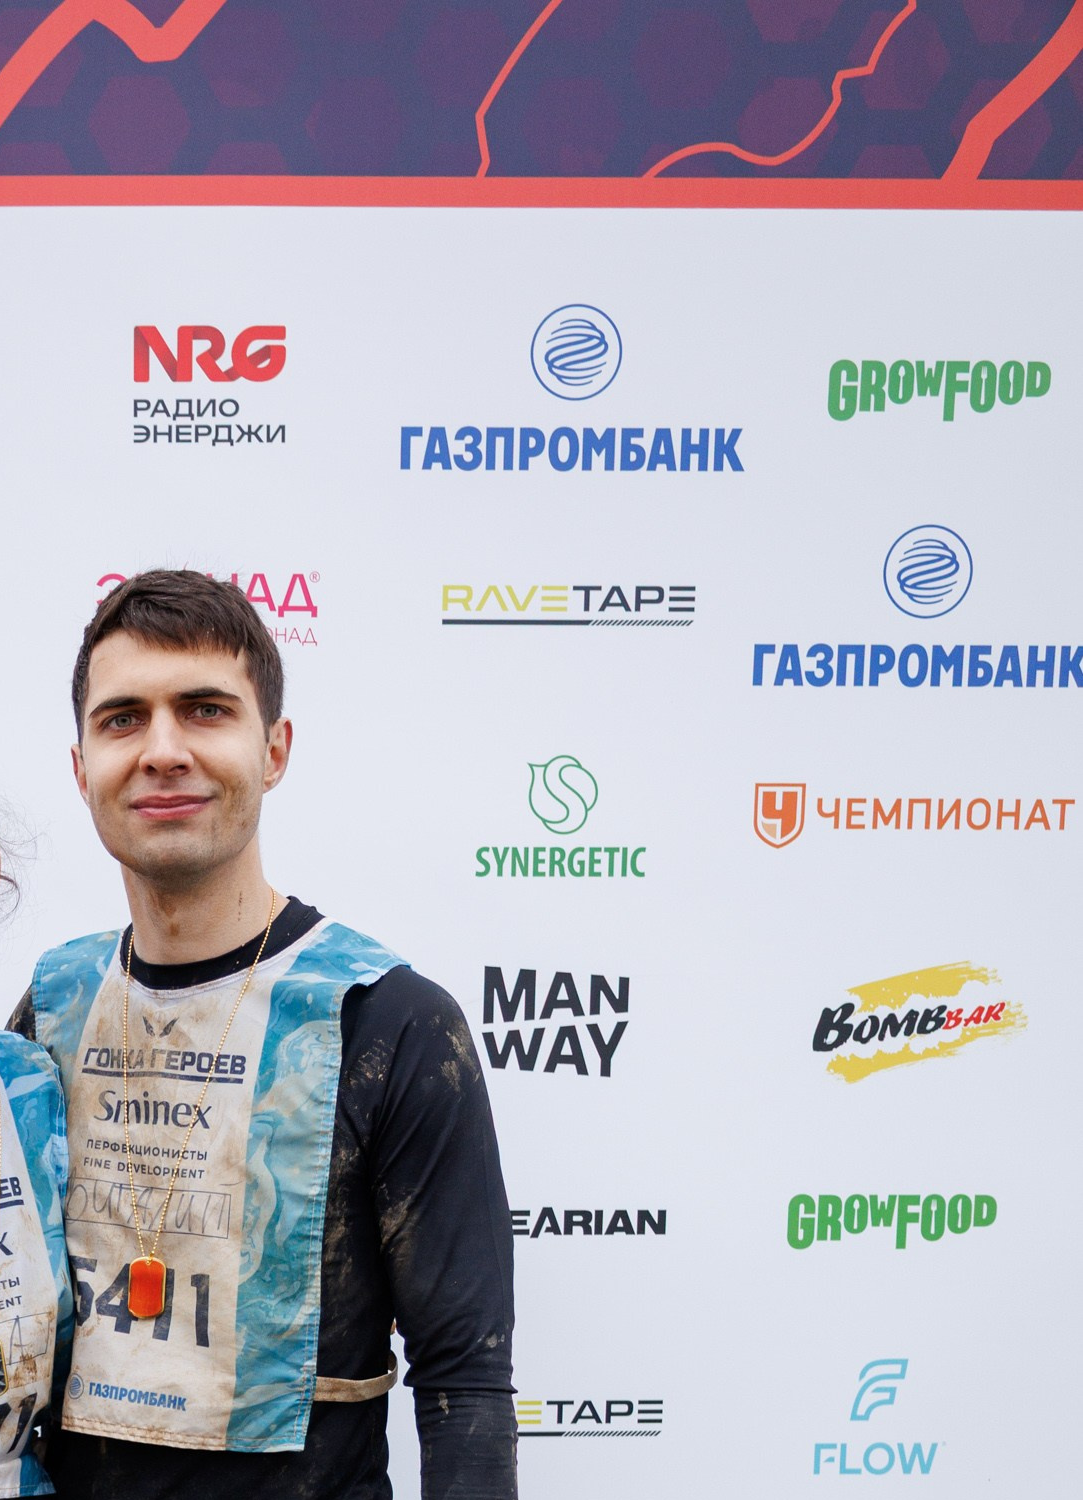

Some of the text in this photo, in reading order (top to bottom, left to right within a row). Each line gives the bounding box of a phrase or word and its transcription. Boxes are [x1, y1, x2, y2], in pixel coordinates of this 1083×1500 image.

[134, 325, 287, 383] NRG
[827, 358, 1052, 423] GROWFOOD
[133, 398, 240, 421] РАДИО
[133, 424, 286, 446] ЭНЕРДЖИ
[400, 426, 745, 473] ГАЗПРОМБАНК
[441, 584, 696, 613] RAVETAPE
[752, 643, 1083, 689] ГАЗПРОМБАНК
[816, 797, 1076, 831] ЧЕМПИОНАТ
[474, 846, 647, 878] SYNERGETIC
[483, 966, 630, 1024] MAN
[83, 1047, 248, 1076] ГОНКА ГЕРОЕВ
[482, 1020, 630, 1078] WAY
[94, 1090, 213, 1130] Sminex
[86, 1139, 209, 1161] ПЕРФЕКЦИОНИСТЫ
[83, 1157, 206, 1180] FINE DEVELOPMENT
[510, 1206, 668, 1239] EARIAN
[786, 1193, 998, 1251] GROWFOOD
[88, 1381, 188, 1412] ГАЗПРОМБАНК
[516, 1399, 664, 1425] ETAPE
[813, 1441, 938, 1476] FLOW
